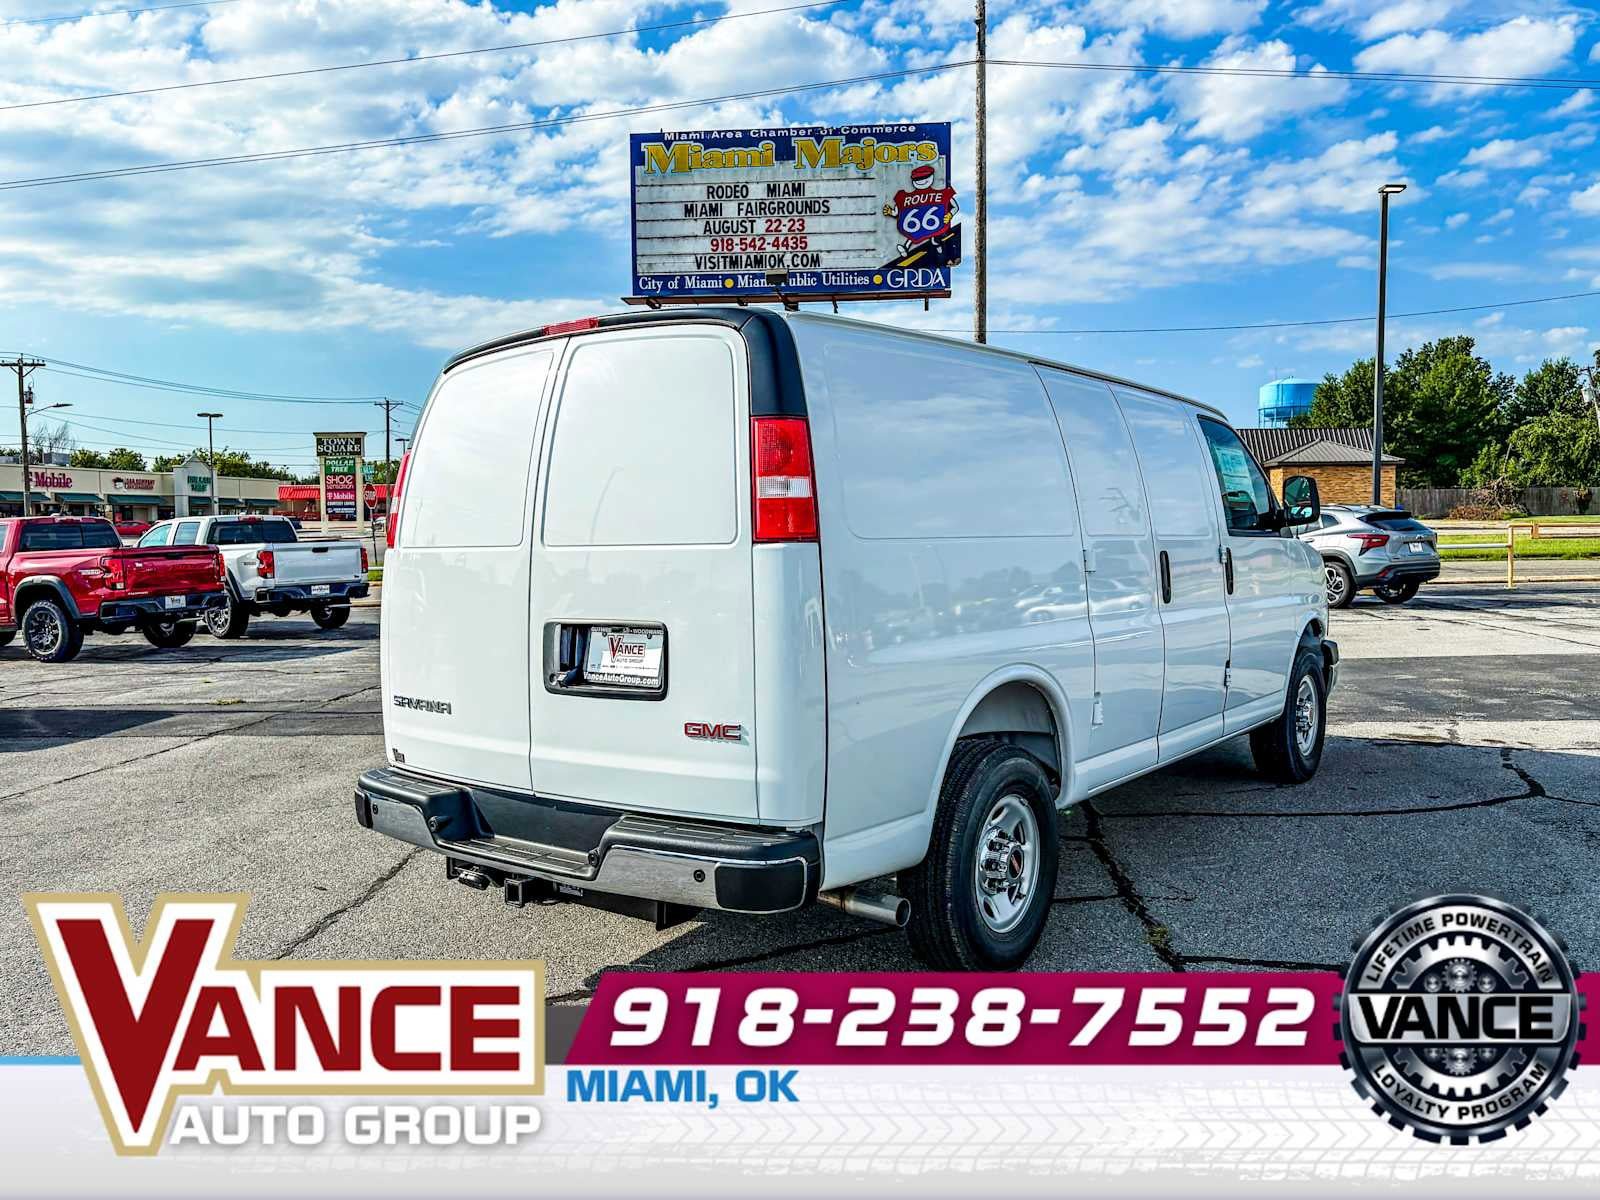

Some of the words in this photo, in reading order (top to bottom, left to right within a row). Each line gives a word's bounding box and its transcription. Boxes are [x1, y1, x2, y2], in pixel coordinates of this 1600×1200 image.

[664, 132, 705, 141] Miami
[711, 129, 743, 139] Area
[749, 127, 813, 138] Chamber
[841, 125, 917, 135] Commerce
[642, 141, 776, 174] Miami
[793, 137, 938, 171] Majors
[706, 184, 749, 199] RODEO
[766, 182, 806, 198] MIAMI
[903, 192, 943, 207] ROUTE
[684, 202, 723, 218] MIAMI
[737, 199, 831, 217] FAIRGROUNDS
[703, 219, 757, 235] AUGUST
[764, 217, 806, 233] 22-23
[902, 206, 941, 233] 66
[710, 235, 809, 252] 918-542-4435
[695, 253, 821, 270] VISITMIAMIOK.COM
[638, 276, 664, 293] City
[667, 276, 681, 289] of
[684, 275, 723, 289] Miami
[781, 273, 817, 287] ublic
[821, 271, 870, 286] Utilities
[886, 268, 946, 288] GRDA
[318, 445, 361, 453] SQUARE
[34, 471, 73, 489] Mobile
[608, 635, 645, 658] VANCE
[583, 671, 660, 687] VanceAutoGroup.com
[393, 695, 452, 715] SAVANA
[684, 722, 742, 741] GMC
